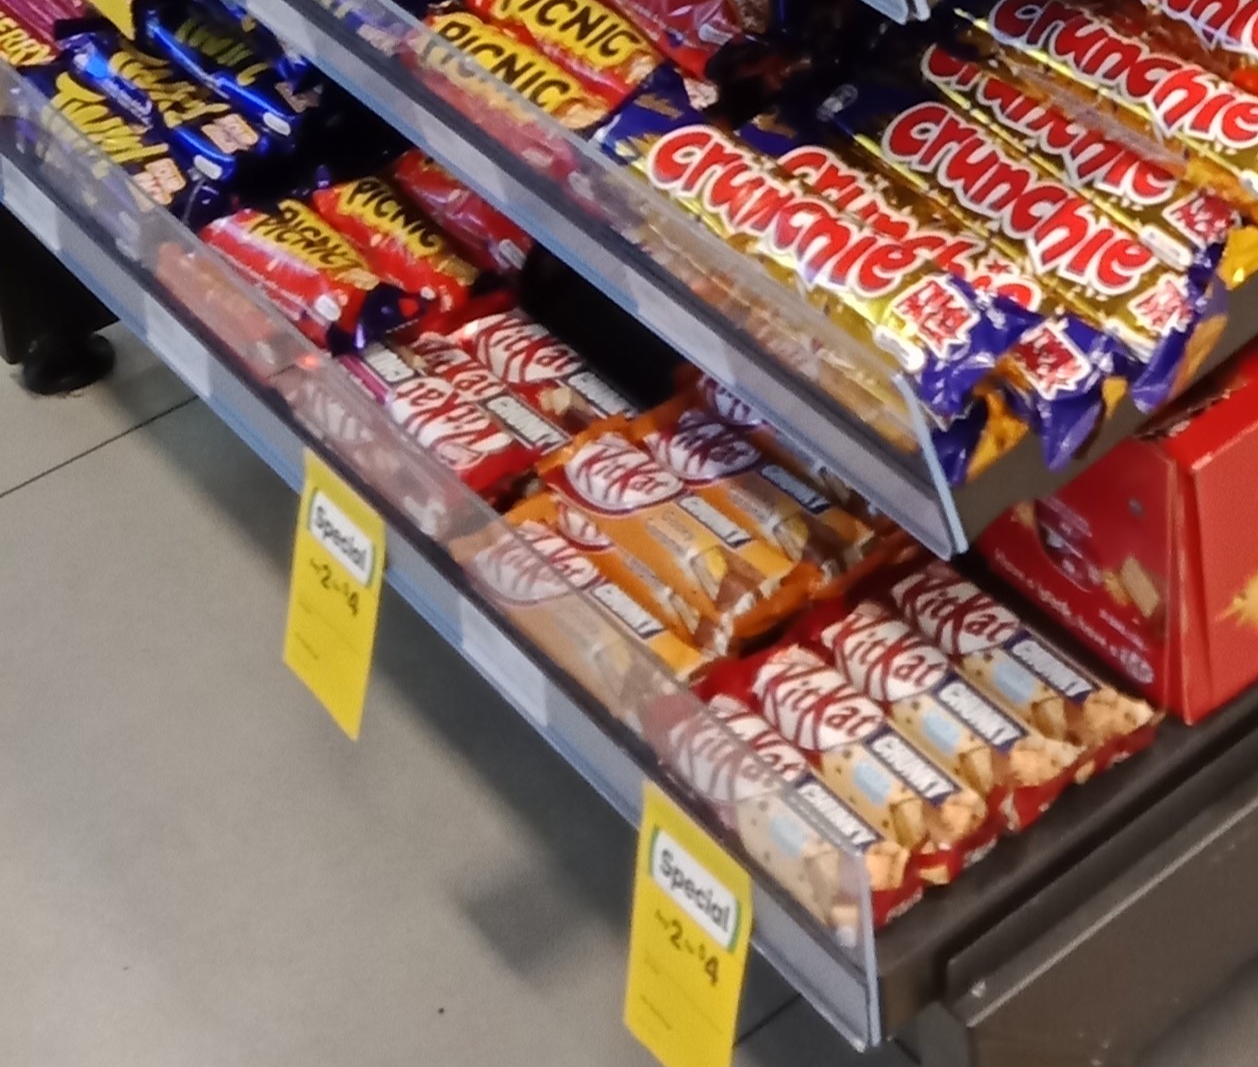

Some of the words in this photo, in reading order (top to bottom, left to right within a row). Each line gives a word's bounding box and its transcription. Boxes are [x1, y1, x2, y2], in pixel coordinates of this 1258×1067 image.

[430, 18, 574, 111] PICNIC
[647, 124, 910, 297] Crunchie
[883, 101, 1157, 296] Crunchie
[660, 848, 731, 934] Special
